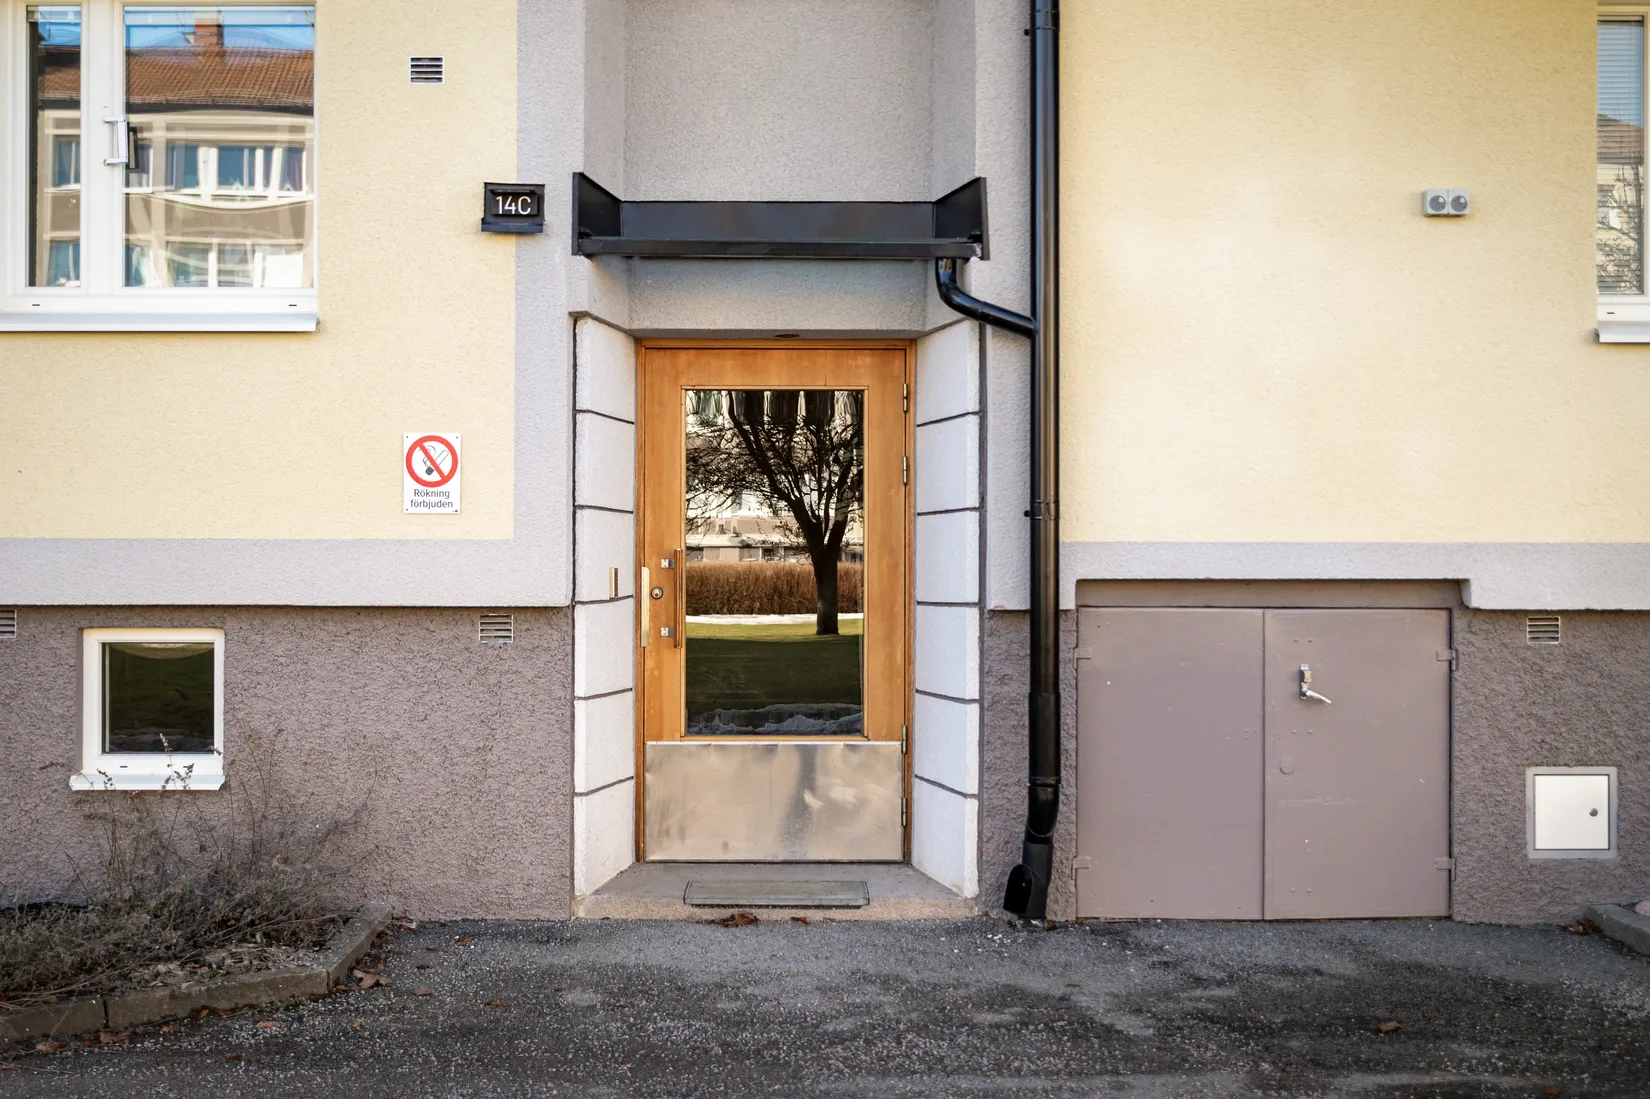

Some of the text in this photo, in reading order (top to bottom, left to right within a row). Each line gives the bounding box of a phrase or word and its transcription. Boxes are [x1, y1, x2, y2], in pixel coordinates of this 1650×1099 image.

[496, 196, 531, 215] 14C
[413, 488, 450, 499] Rökning
[410, 499, 453, 509] förbjuden
